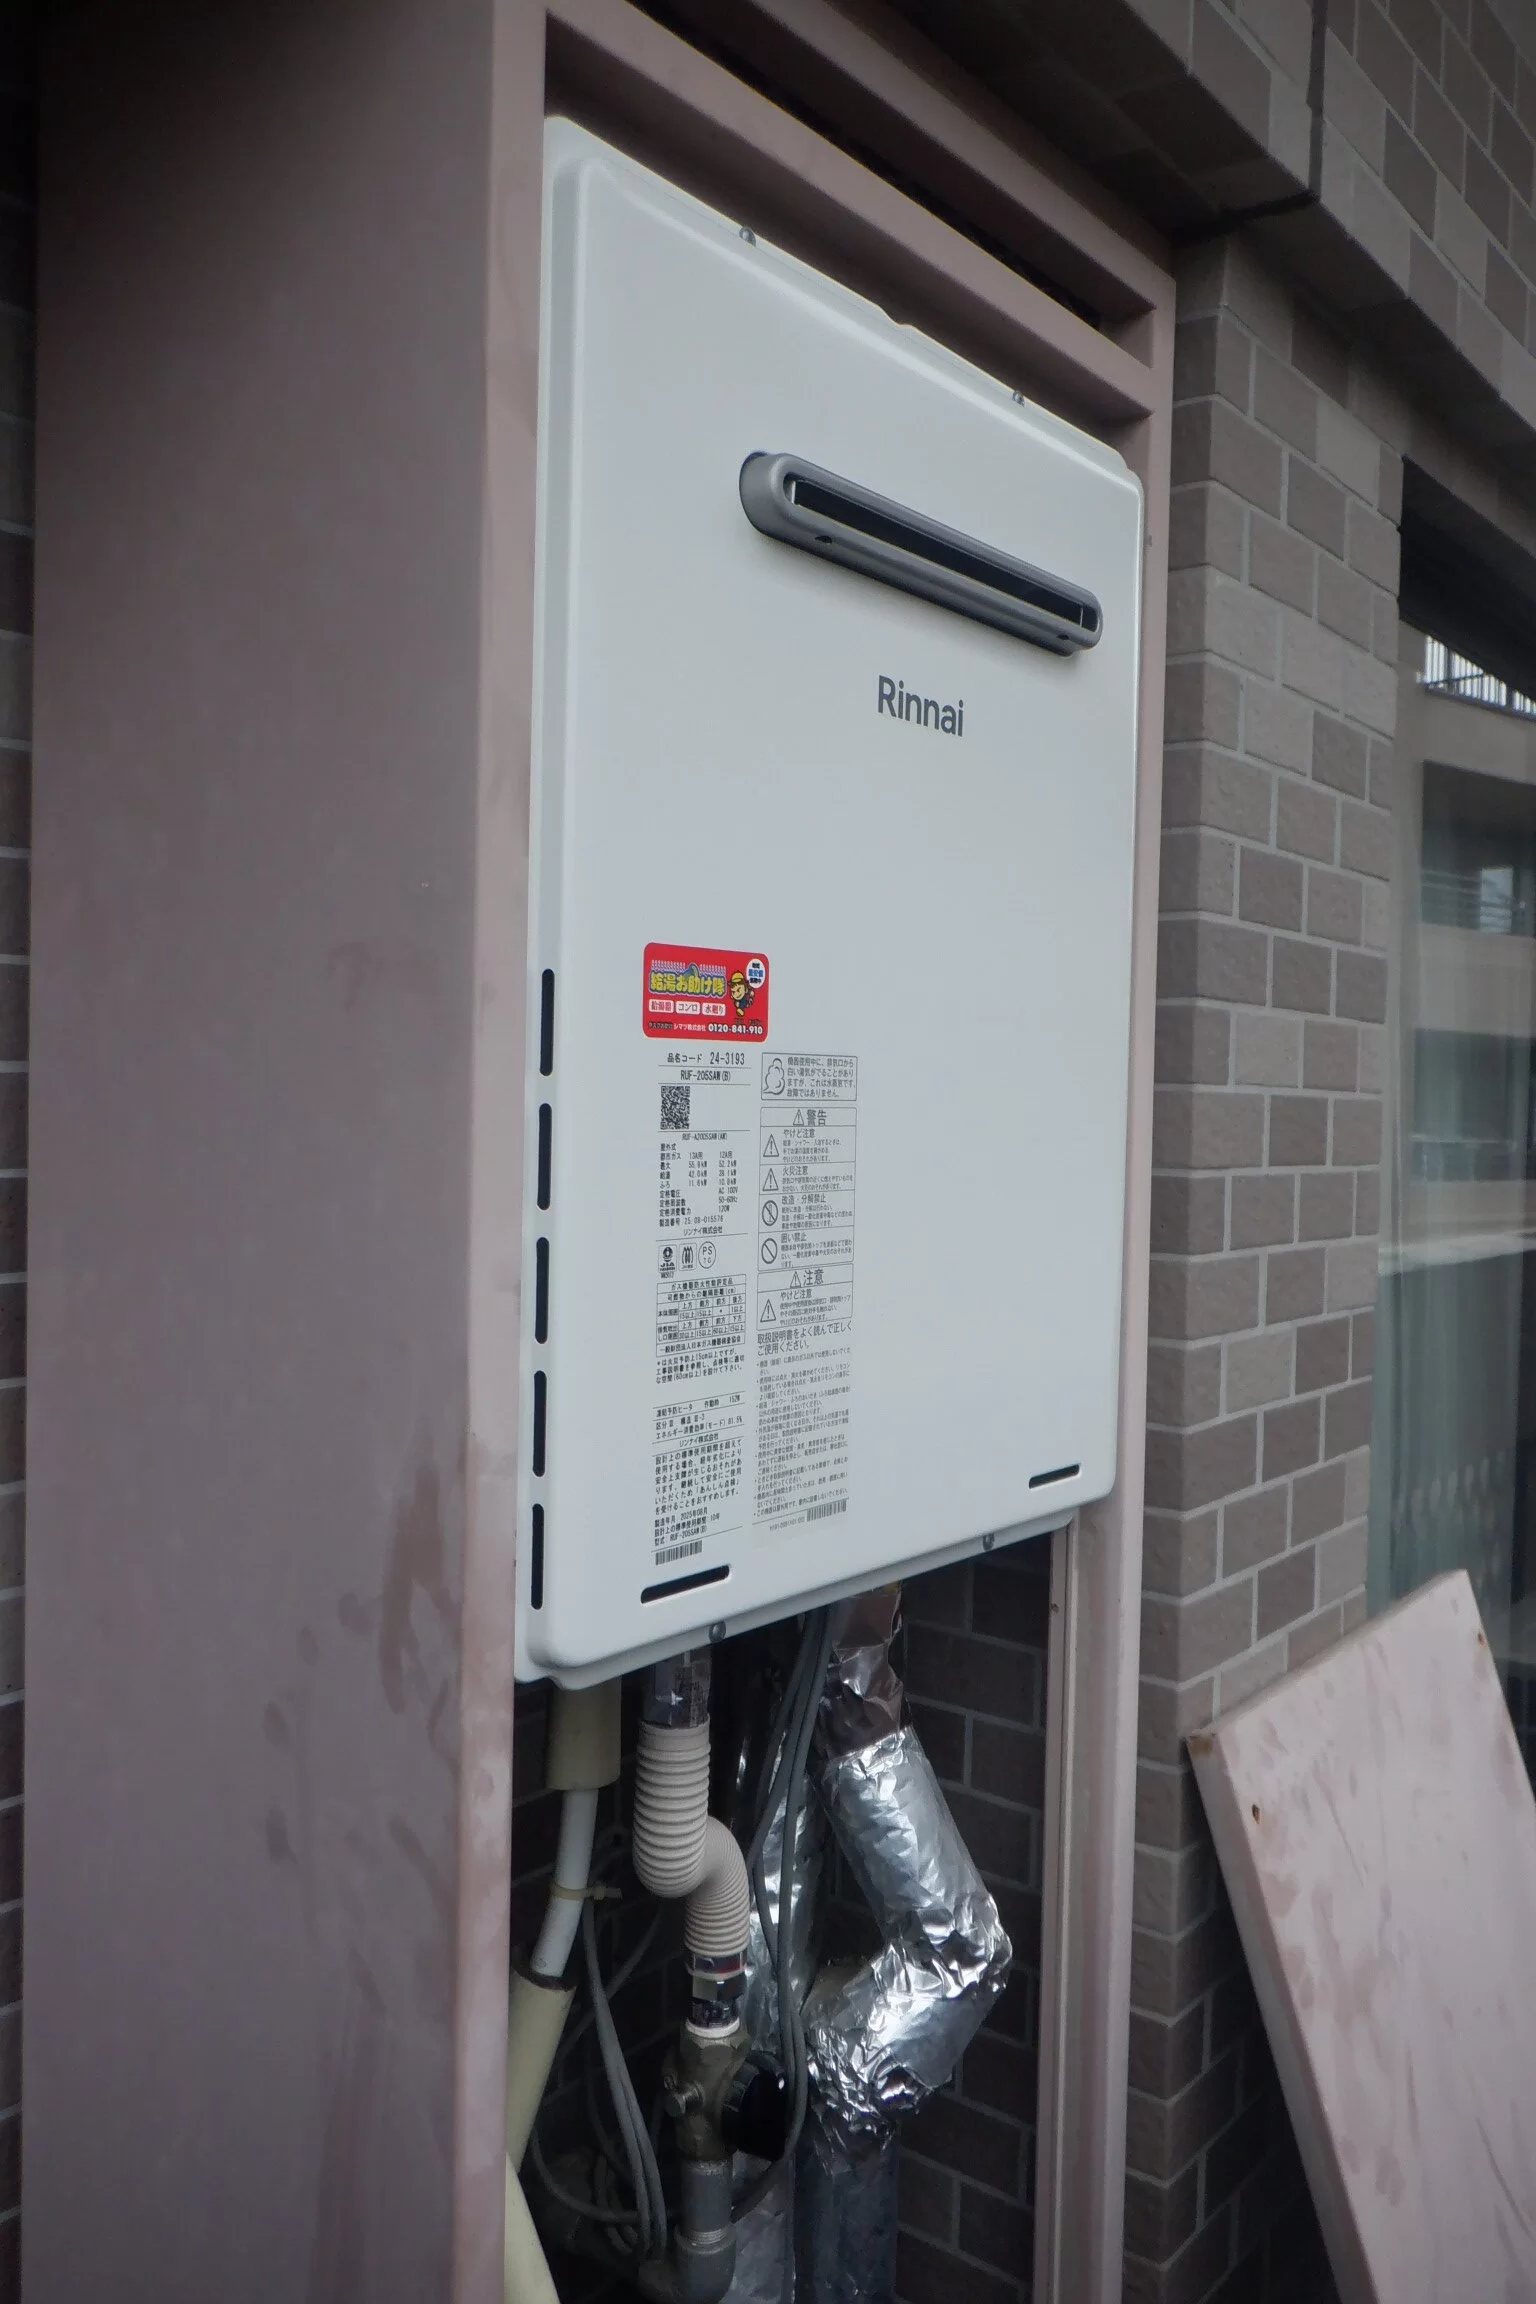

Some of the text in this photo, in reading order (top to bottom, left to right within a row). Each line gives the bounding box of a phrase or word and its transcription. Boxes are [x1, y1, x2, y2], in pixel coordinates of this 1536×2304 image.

[878, 674, 964, 738] Rinnai
[650, 971, 725, 997] 給湯お助け隊
[678, 1004, 698, 1012] コンロ
[708, 1023, 763, 1034] 0120-841-910
[667, 1051, 745, 1065] 品名コード 24-3193
[787, 1067, 854, 1077] 白い湯気がでることがあり
[787, 1078, 856, 1088] ますが、これは水蒸気です。
[787, 1088, 840, 1098] 故障ではありません。
[806, 1109, 827, 1126] 警告
[783, 1128, 815, 1138] やけど注意
[782, 1165, 809, 1176] 火災注意
[781, 1193, 827, 1205] 改造・分解禁止
[683, 1226, 723, 1236] リンナイ株式会社
[702, 1246, 713, 1256] PS
[803, 1269, 824, 1286] 注意
[780, 1288, 812, 1301] やけど注意
[682, 1301, 693, 1310] 上方
[757, 1320, 852, 1344] 取扱説明書をよく読んで正しく
[757, 1340, 810, 1356] ご使用ください。
[680, 1433, 719, 1448] リンナイ株式会社
